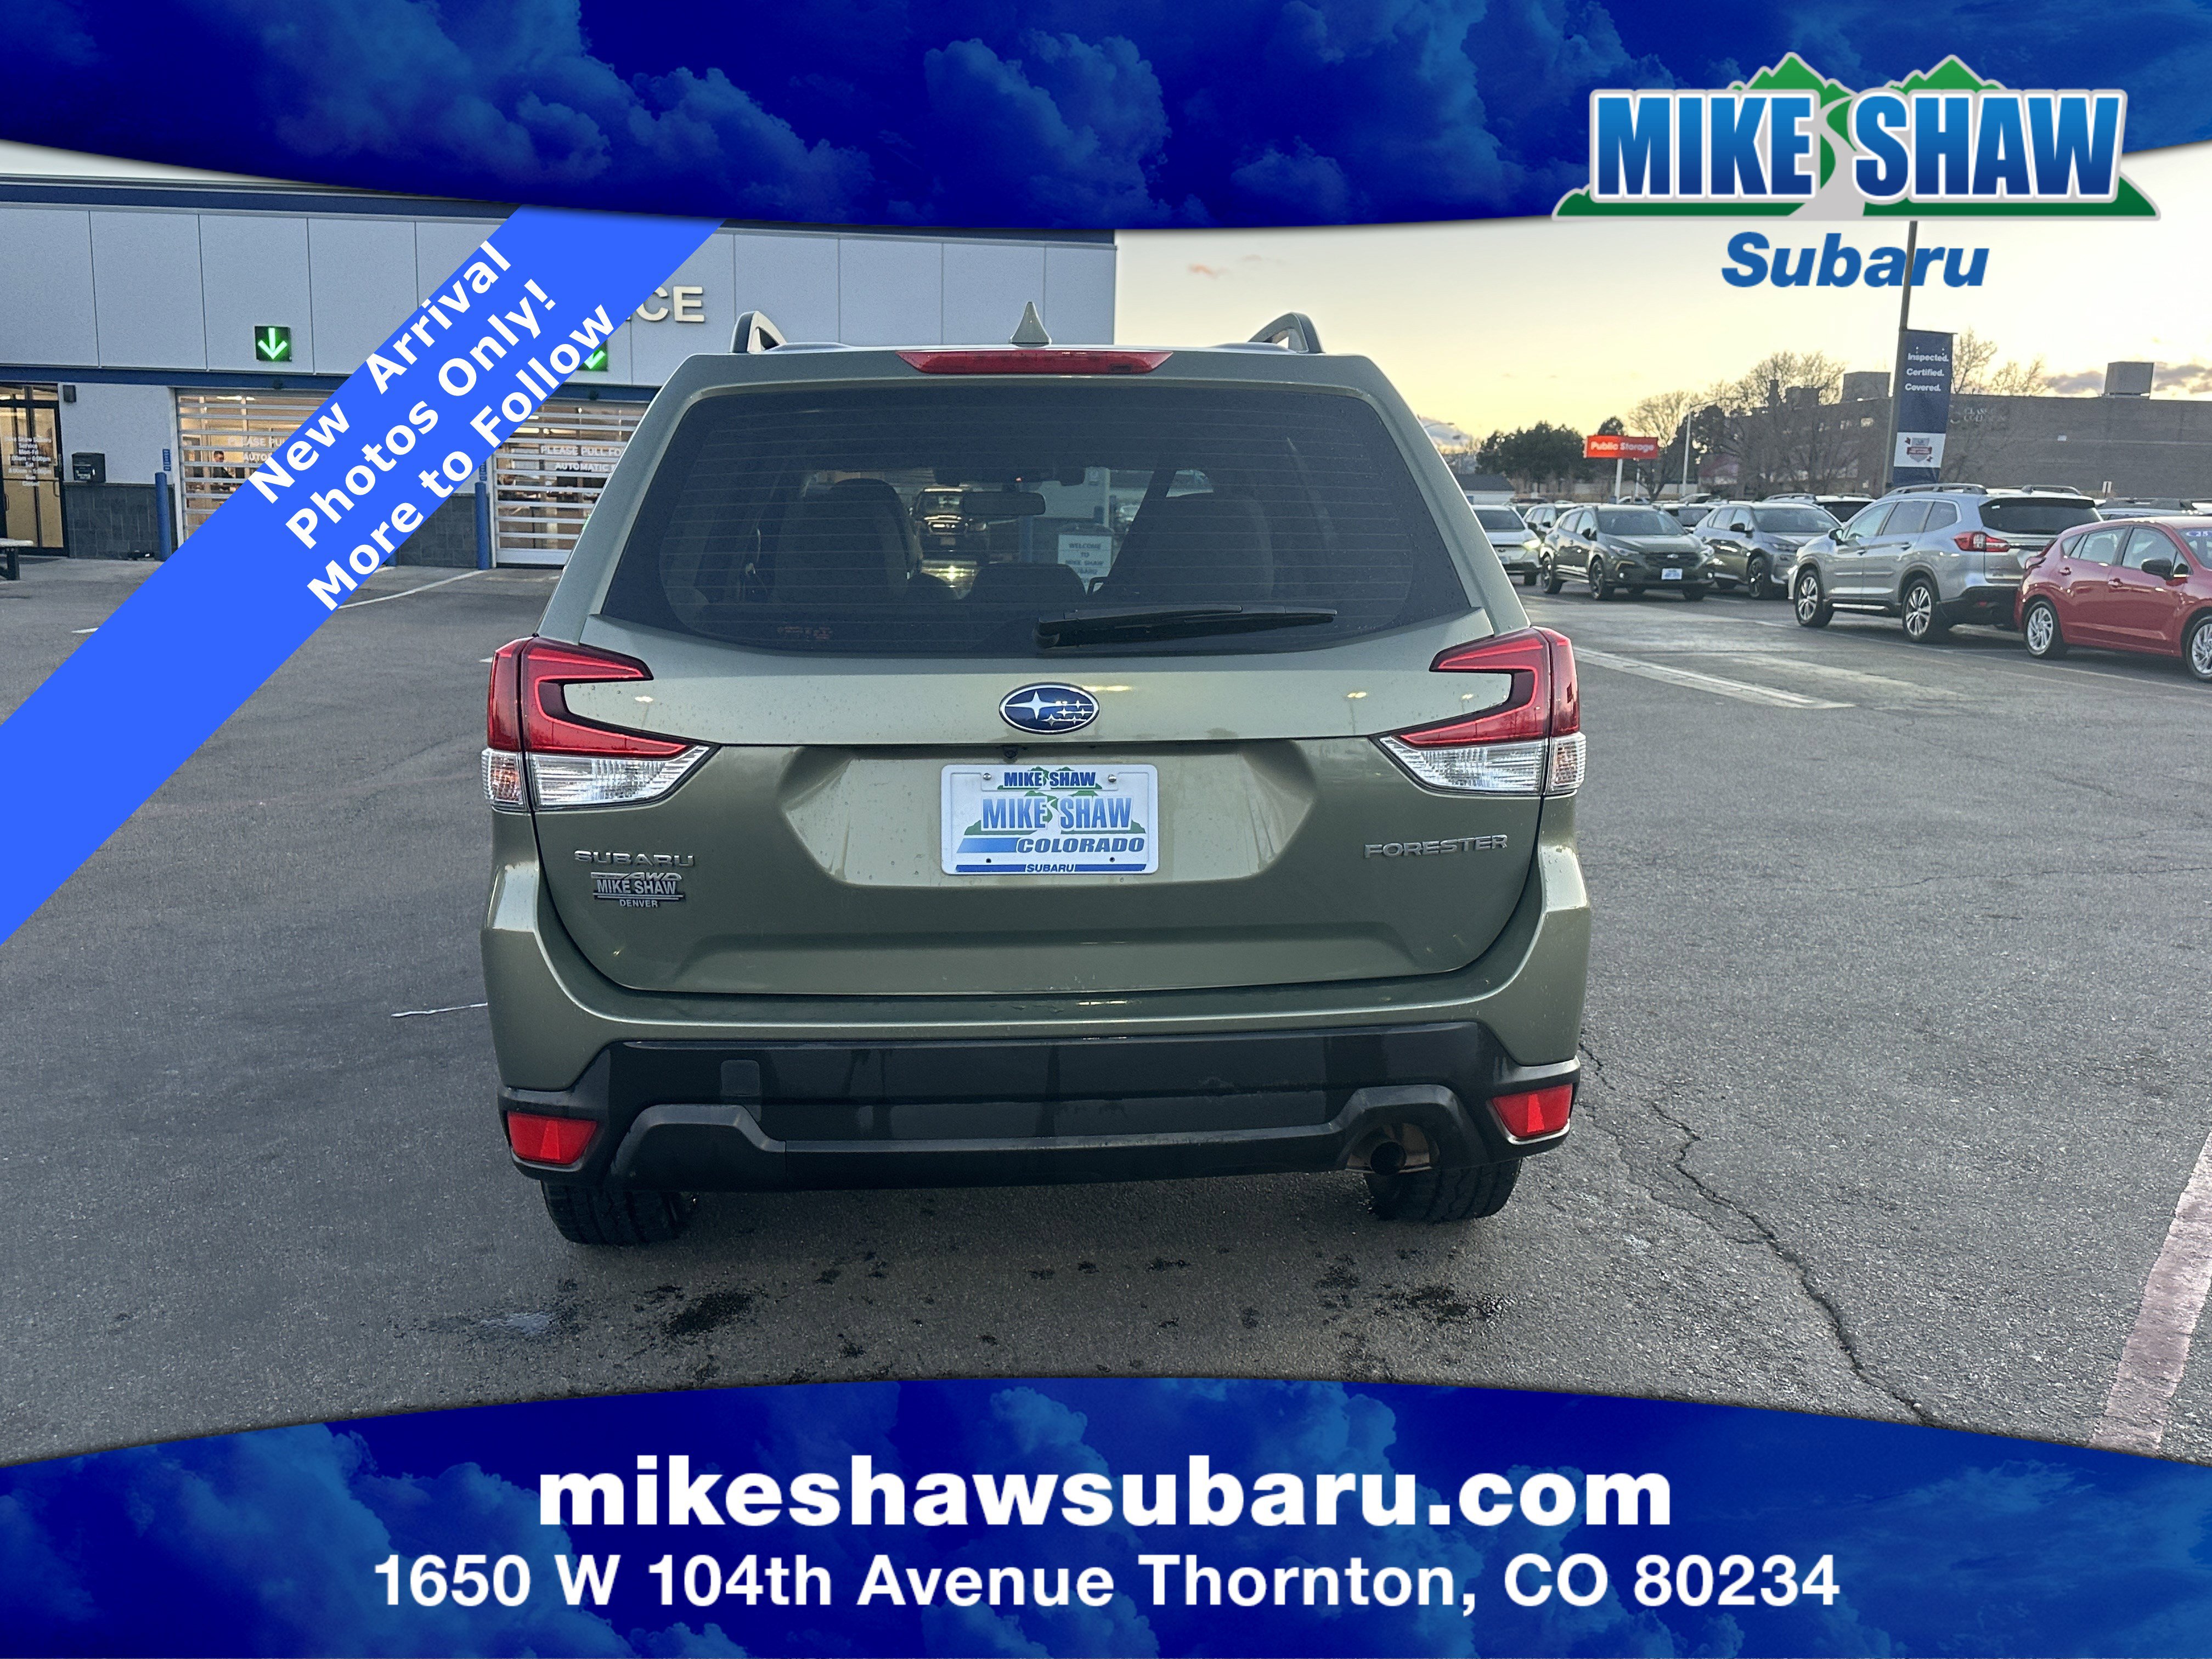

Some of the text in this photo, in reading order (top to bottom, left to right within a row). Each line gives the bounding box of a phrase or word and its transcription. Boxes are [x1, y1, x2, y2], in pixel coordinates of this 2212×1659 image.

[626, 286, 705, 323] CE
[1908, 353, 1949, 362] Inspected.
[1906, 368, 1944, 376] Certified.
[1905, 383, 1941, 392] Covered.
[540, 445, 578, 455] PLEASE
[580, 446, 608, 456] PULL
[1590, 441, 1655, 453] Public Storage
[555, 462, 608, 471] AUTOMATIC
[1003, 771, 1096, 787] MIKE SHAW
[982, 797, 1132, 830] MIKE SHAW
[1017, 837, 1145, 853] COLORADO
[1364, 834, 1508, 859] FORESTER
[574, 850, 695, 867] SUBARU
[1026, 864, 1076, 873] SUBARU
[623, 872, 683, 881] AWD
[596, 879, 676, 895] MIKE SHAW
[619, 899, 659, 908] DENVER
